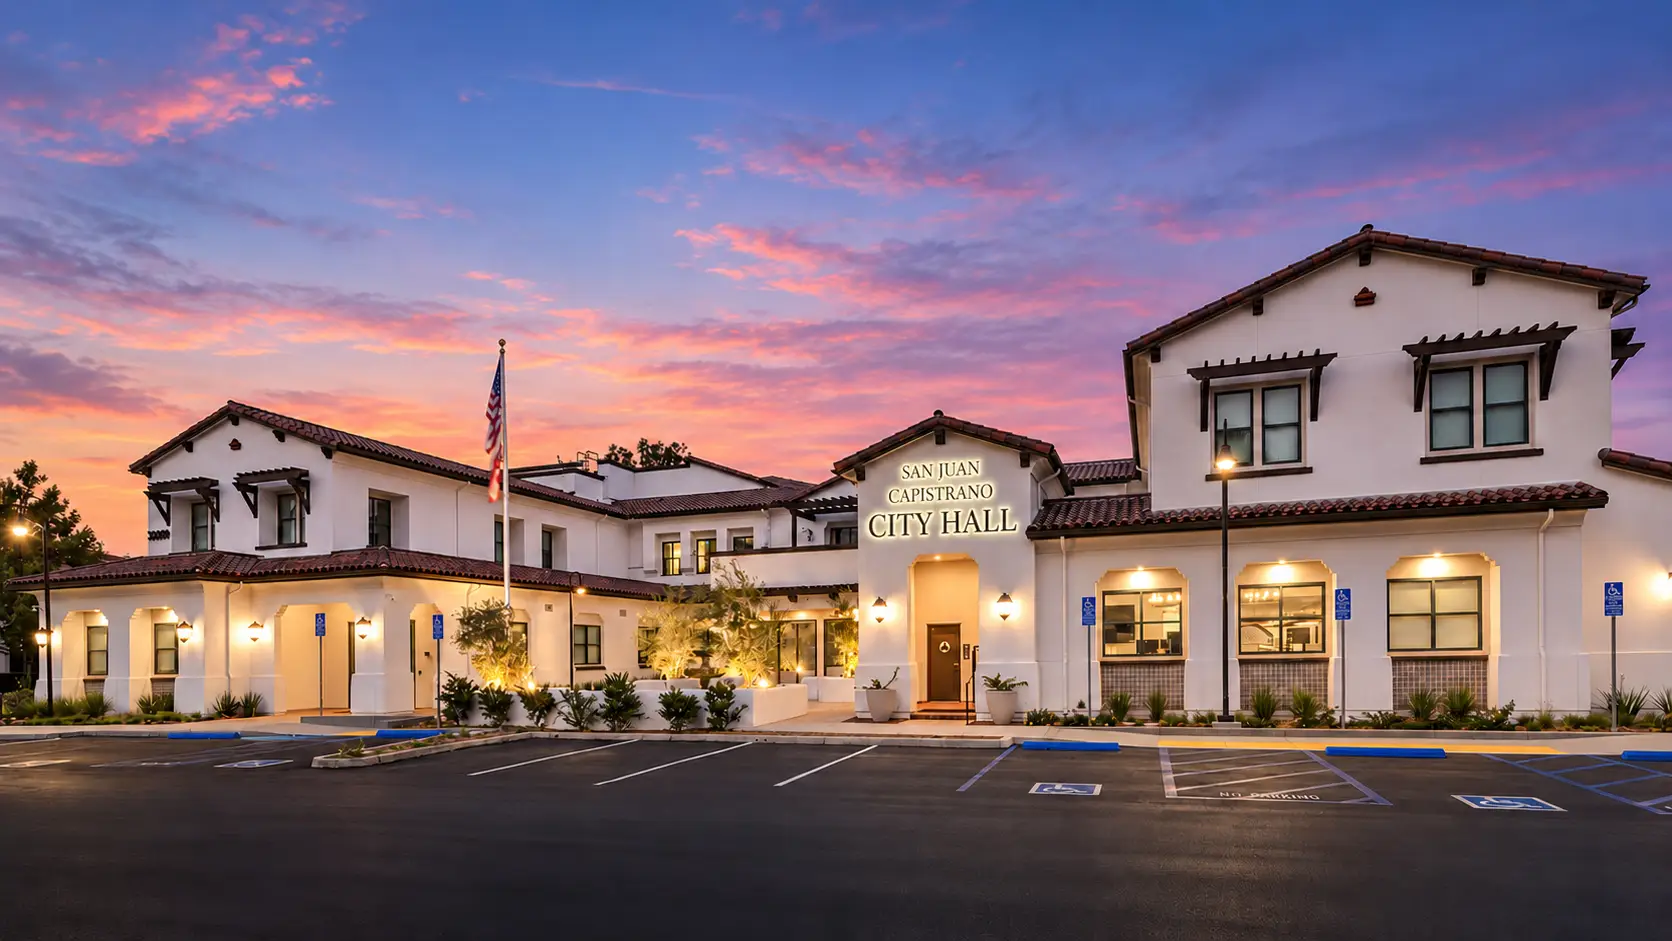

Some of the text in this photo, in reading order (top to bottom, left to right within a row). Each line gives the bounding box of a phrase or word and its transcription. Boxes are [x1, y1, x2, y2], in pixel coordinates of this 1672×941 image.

[902, 460, 980, 481] SAN JUAN
[888, 483, 993, 504] CAPISTRANO
[868, 508, 1017, 538] CITY HALL
[1250, 792, 1320, 800] PARKING
